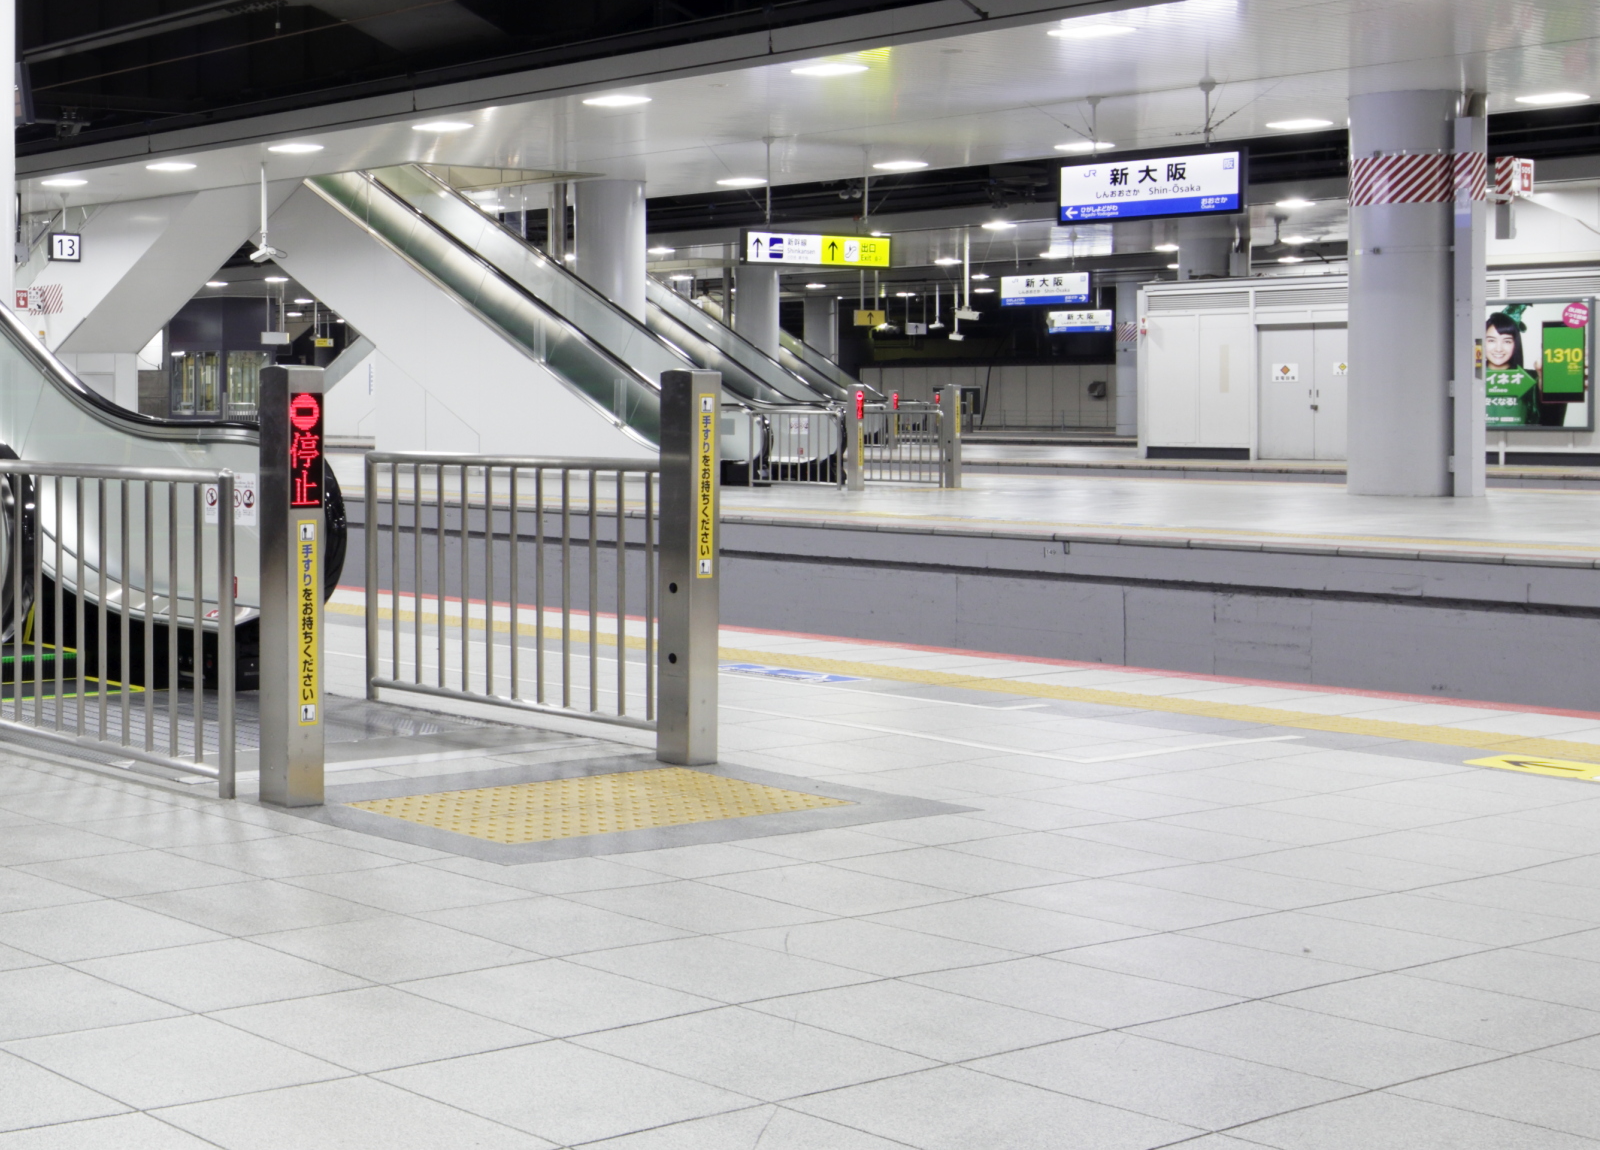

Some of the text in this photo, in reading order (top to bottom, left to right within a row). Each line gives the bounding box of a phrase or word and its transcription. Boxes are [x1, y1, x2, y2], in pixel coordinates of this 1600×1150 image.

[1084, 169, 1097, 178] JR
[1109, 162, 1187, 186] 新大阪
[1521, 166, 1531, 174] SOS
[1095, 188, 1141, 199] しんおおさか
[1148, 183, 1201, 196] Shin-Ōsaka
[57, 238, 75, 257] 13
[787, 247, 816, 255] Shinkansen
[861, 243, 876, 253] 出口
[1025, 276, 1063, 288] 新大阪
[1067, 313, 1094, 321] 新大阪
[290, 432, 320, 505] 停止
[700, 415, 711, 556] 手すりをお持ちください
[301, 543, 314, 701] 手すりをお持ちください
